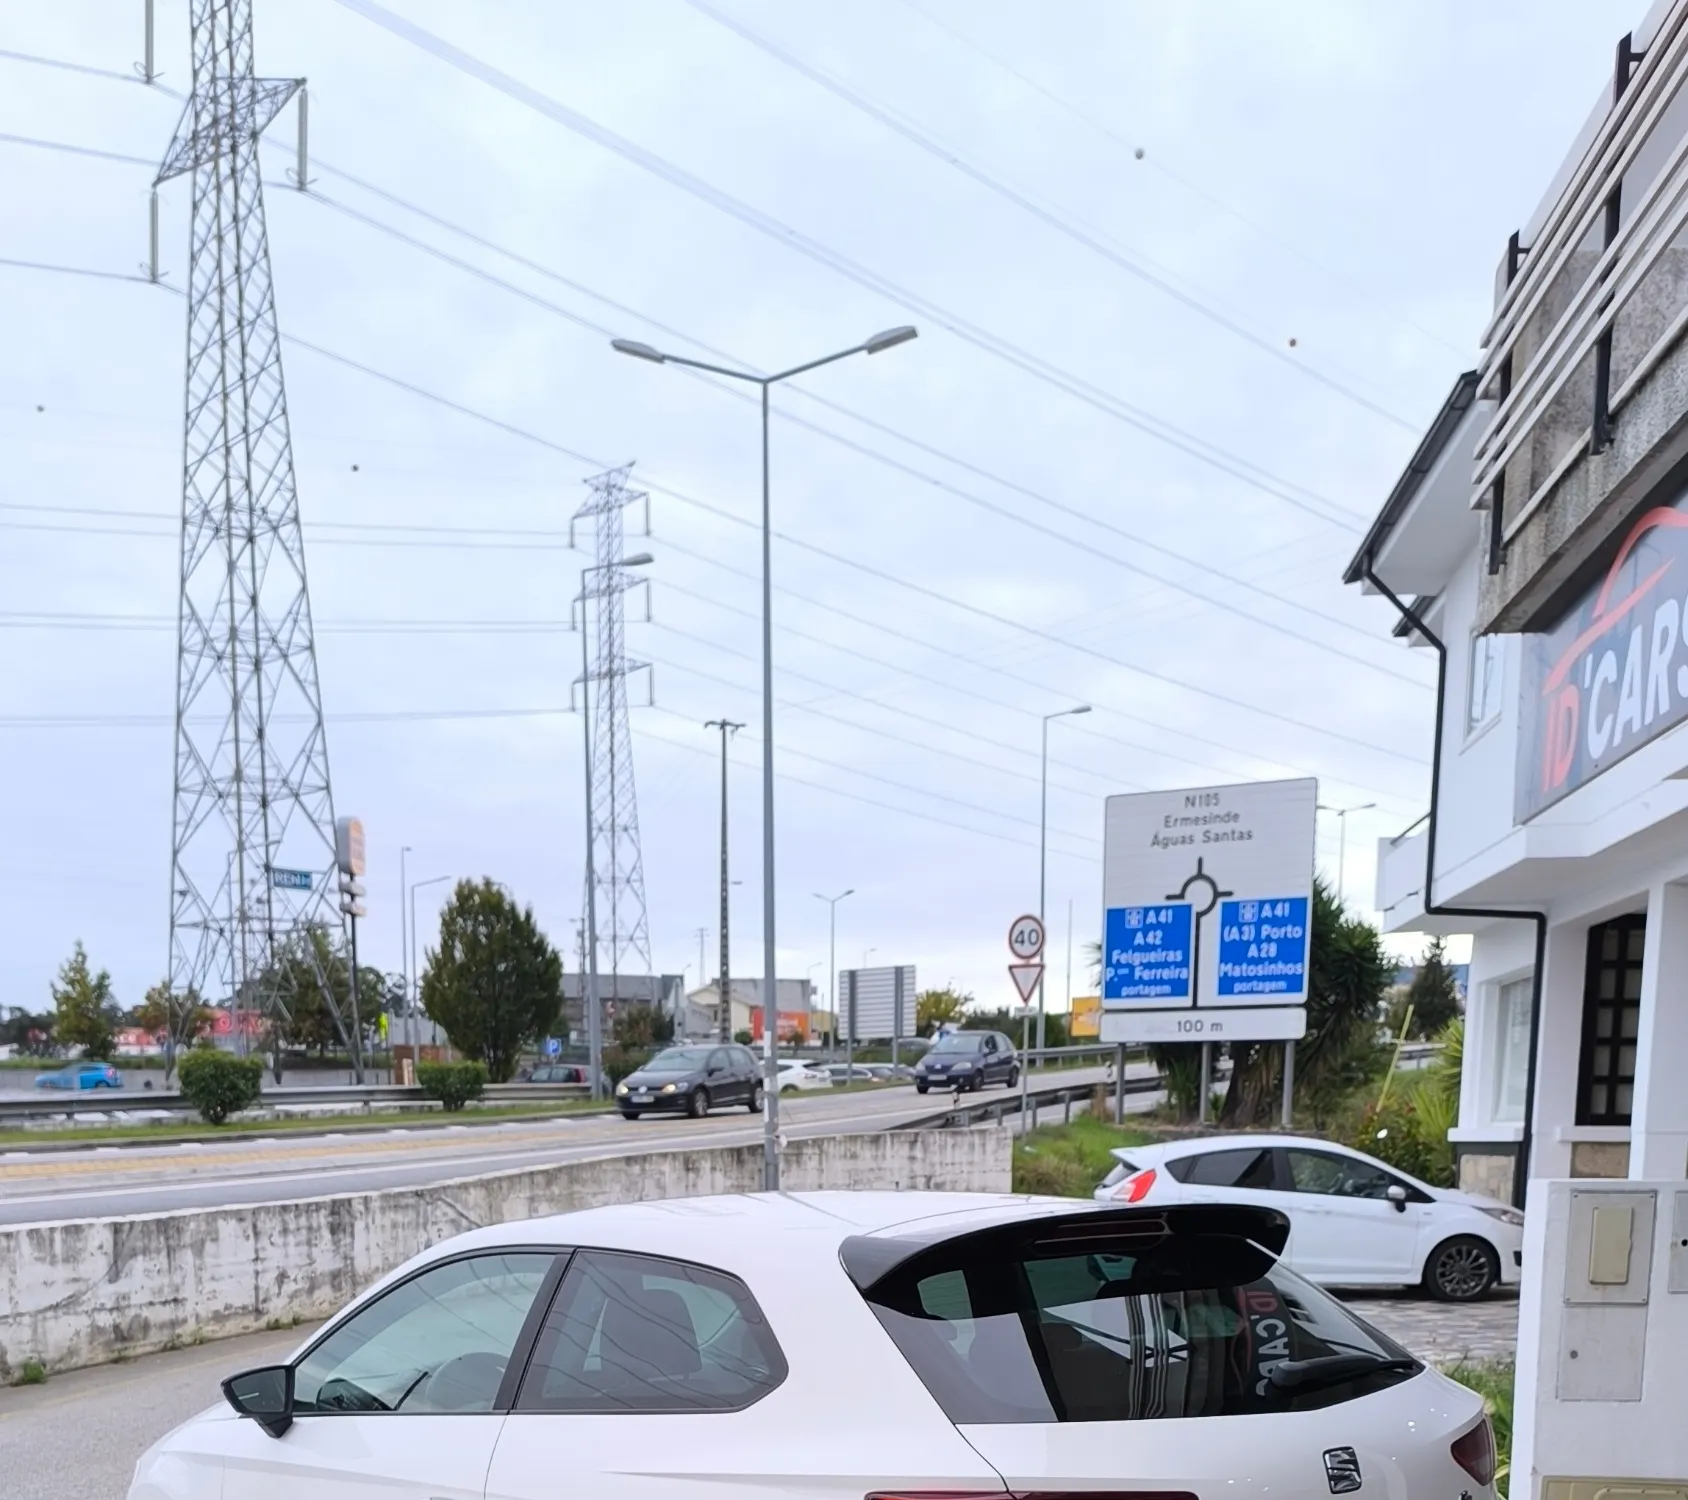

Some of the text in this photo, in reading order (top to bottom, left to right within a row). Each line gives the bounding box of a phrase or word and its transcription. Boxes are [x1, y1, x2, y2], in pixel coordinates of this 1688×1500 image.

[1184, 793, 1220, 808] N105
[1163, 811, 1240, 829] Ermesinde
[1150, 829, 1253, 850] Águas Santas
[1014, 929, 1040, 946] 40
[1260, 923, 1303, 940] Porto
[1111, 948, 1183, 966] Felgueiras
[1134, 964, 1189, 981] Ferreira
[1219, 961, 1304, 978] Matosinhos
[1121, 984, 1172, 998] portagem
[1233, 980, 1287, 994] portagem
[1177, 1019, 1223, 1033] 100 m
